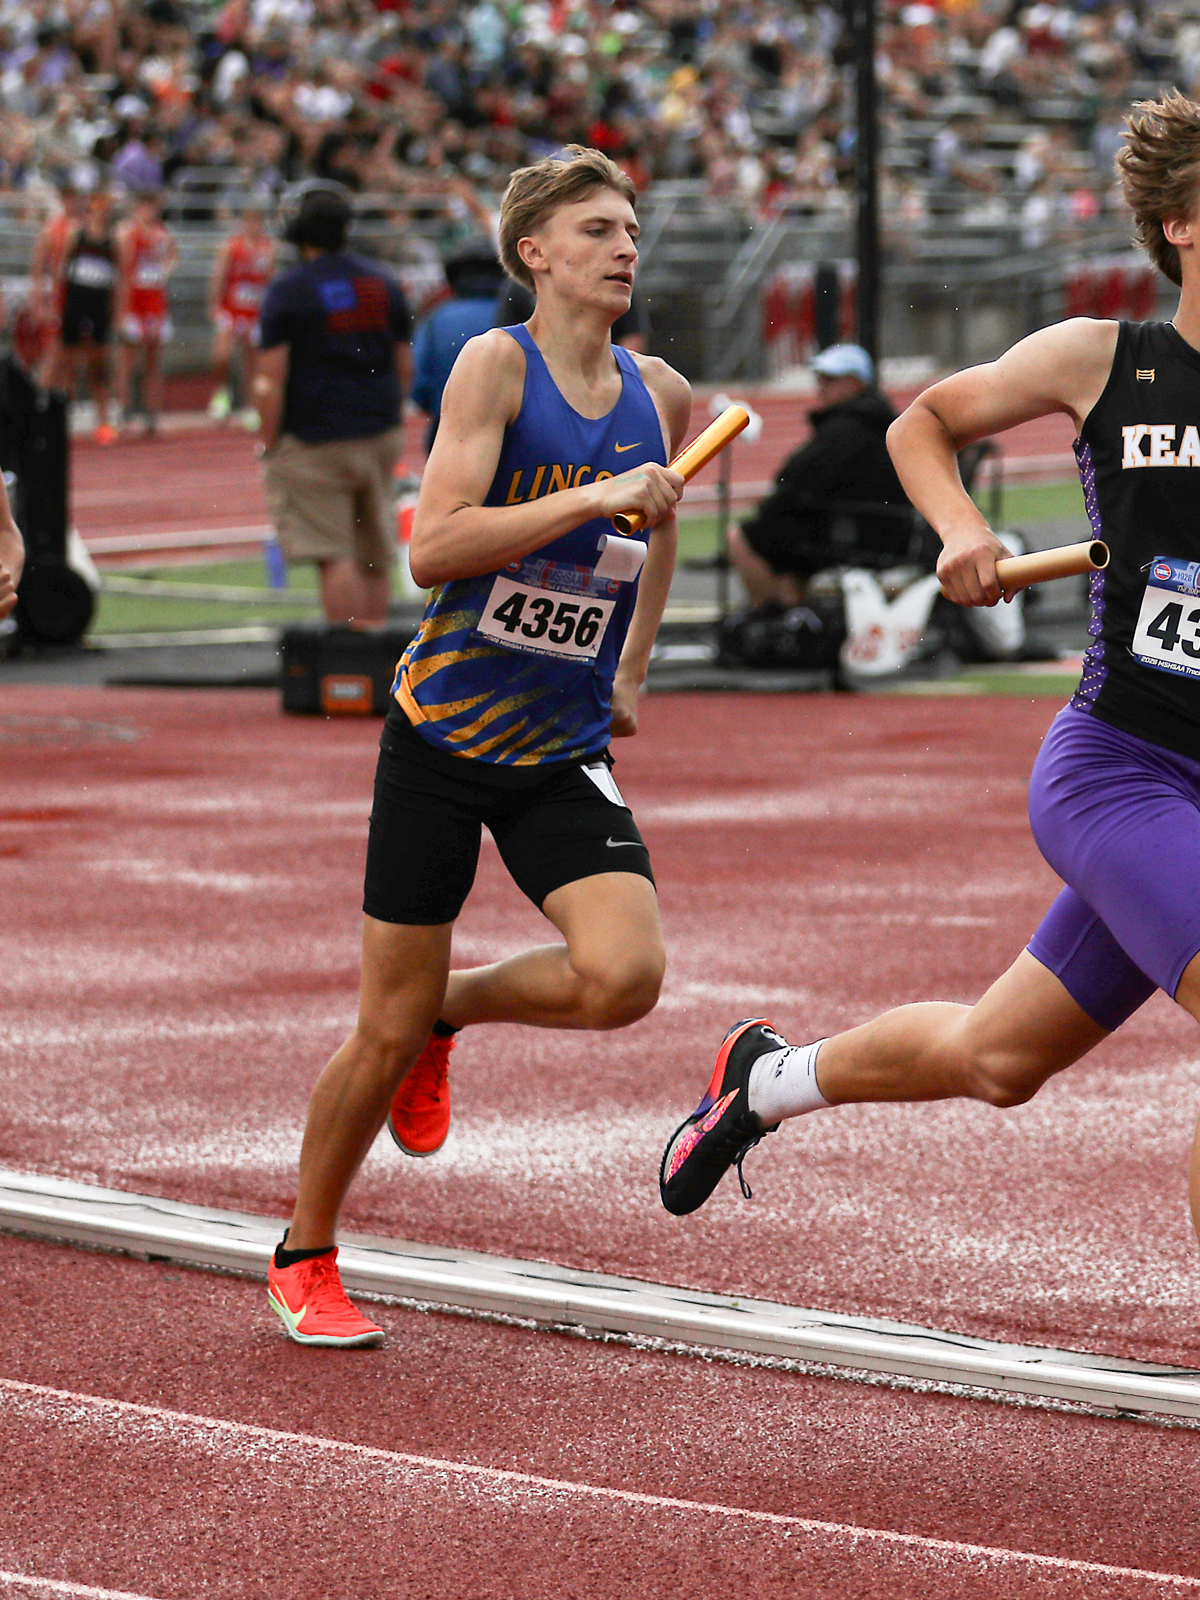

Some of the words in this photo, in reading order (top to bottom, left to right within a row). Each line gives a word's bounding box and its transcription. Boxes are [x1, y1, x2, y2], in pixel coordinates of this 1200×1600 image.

[505, 464, 615, 505] LINC
[492, 592, 604, 647] 4356
[1158, 660, 1186, 672] MSHSAA
